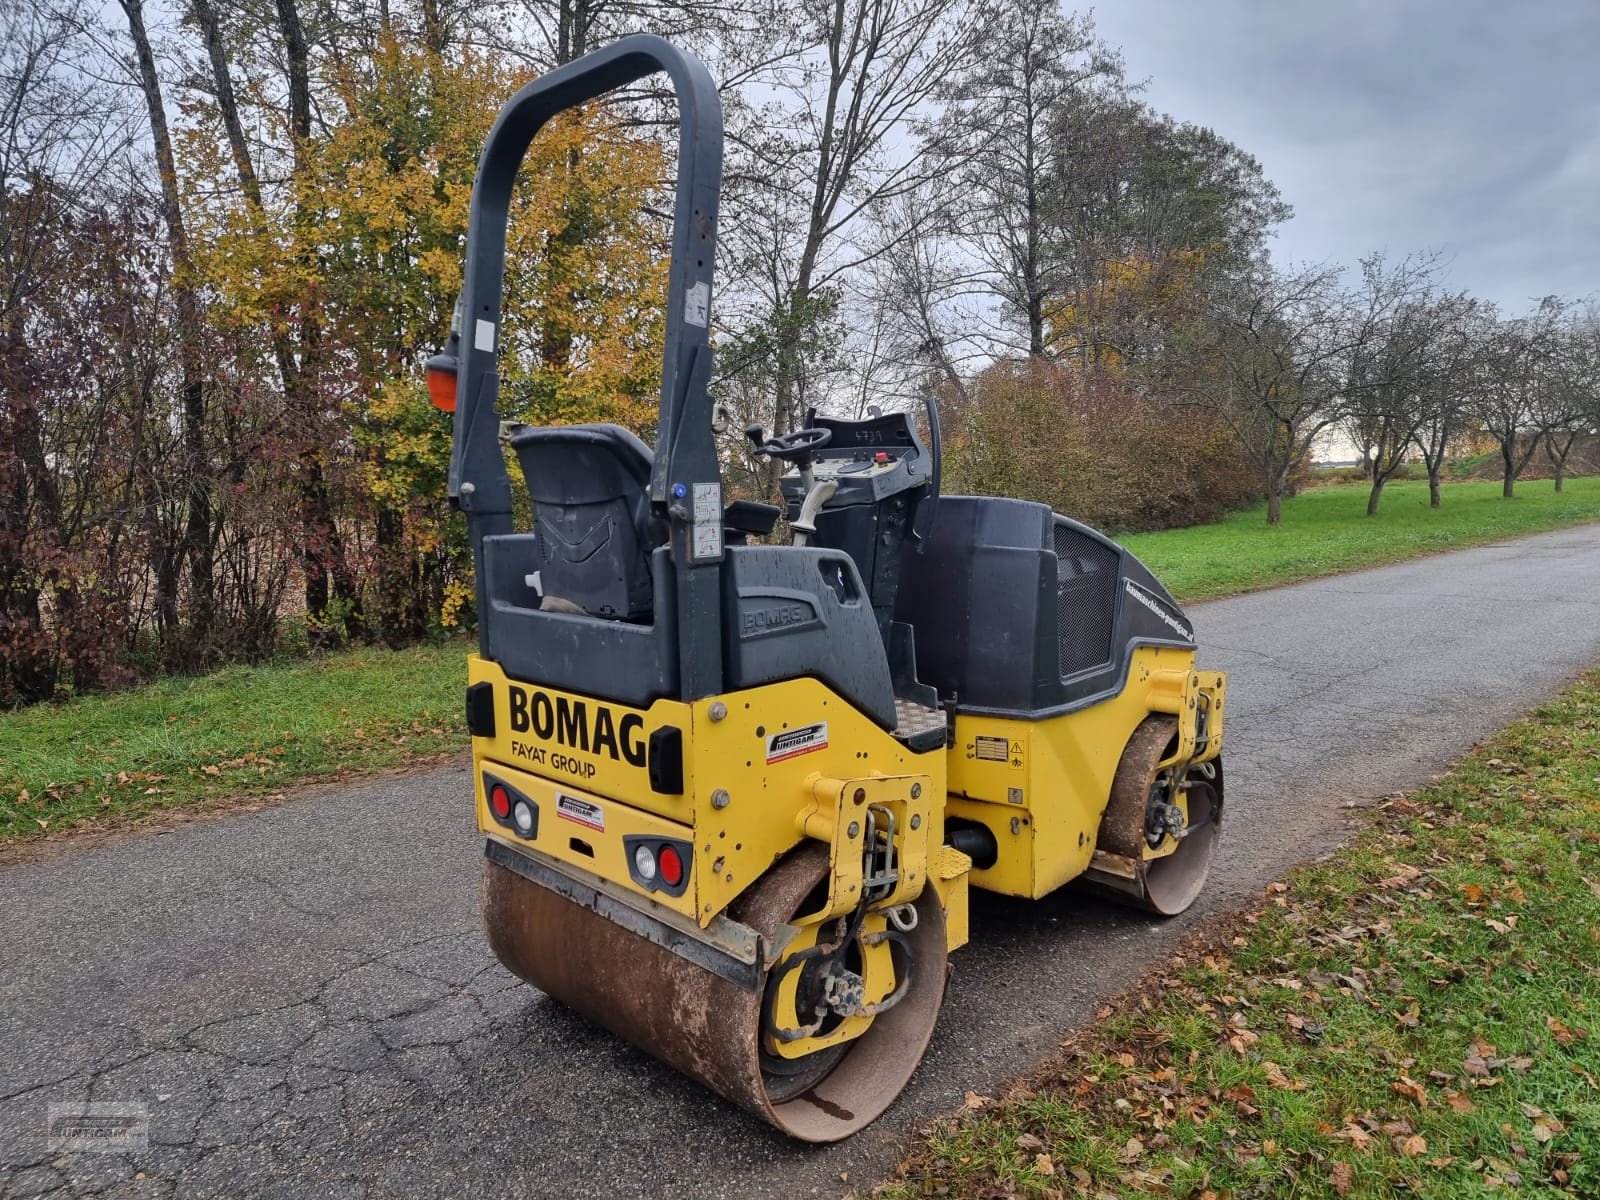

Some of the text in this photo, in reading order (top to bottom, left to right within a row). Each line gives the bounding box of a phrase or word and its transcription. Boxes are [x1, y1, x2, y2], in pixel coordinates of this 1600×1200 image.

[508, 685, 647, 768] BOMAG
[511, 740, 596, 780] FAYAT GROUP
